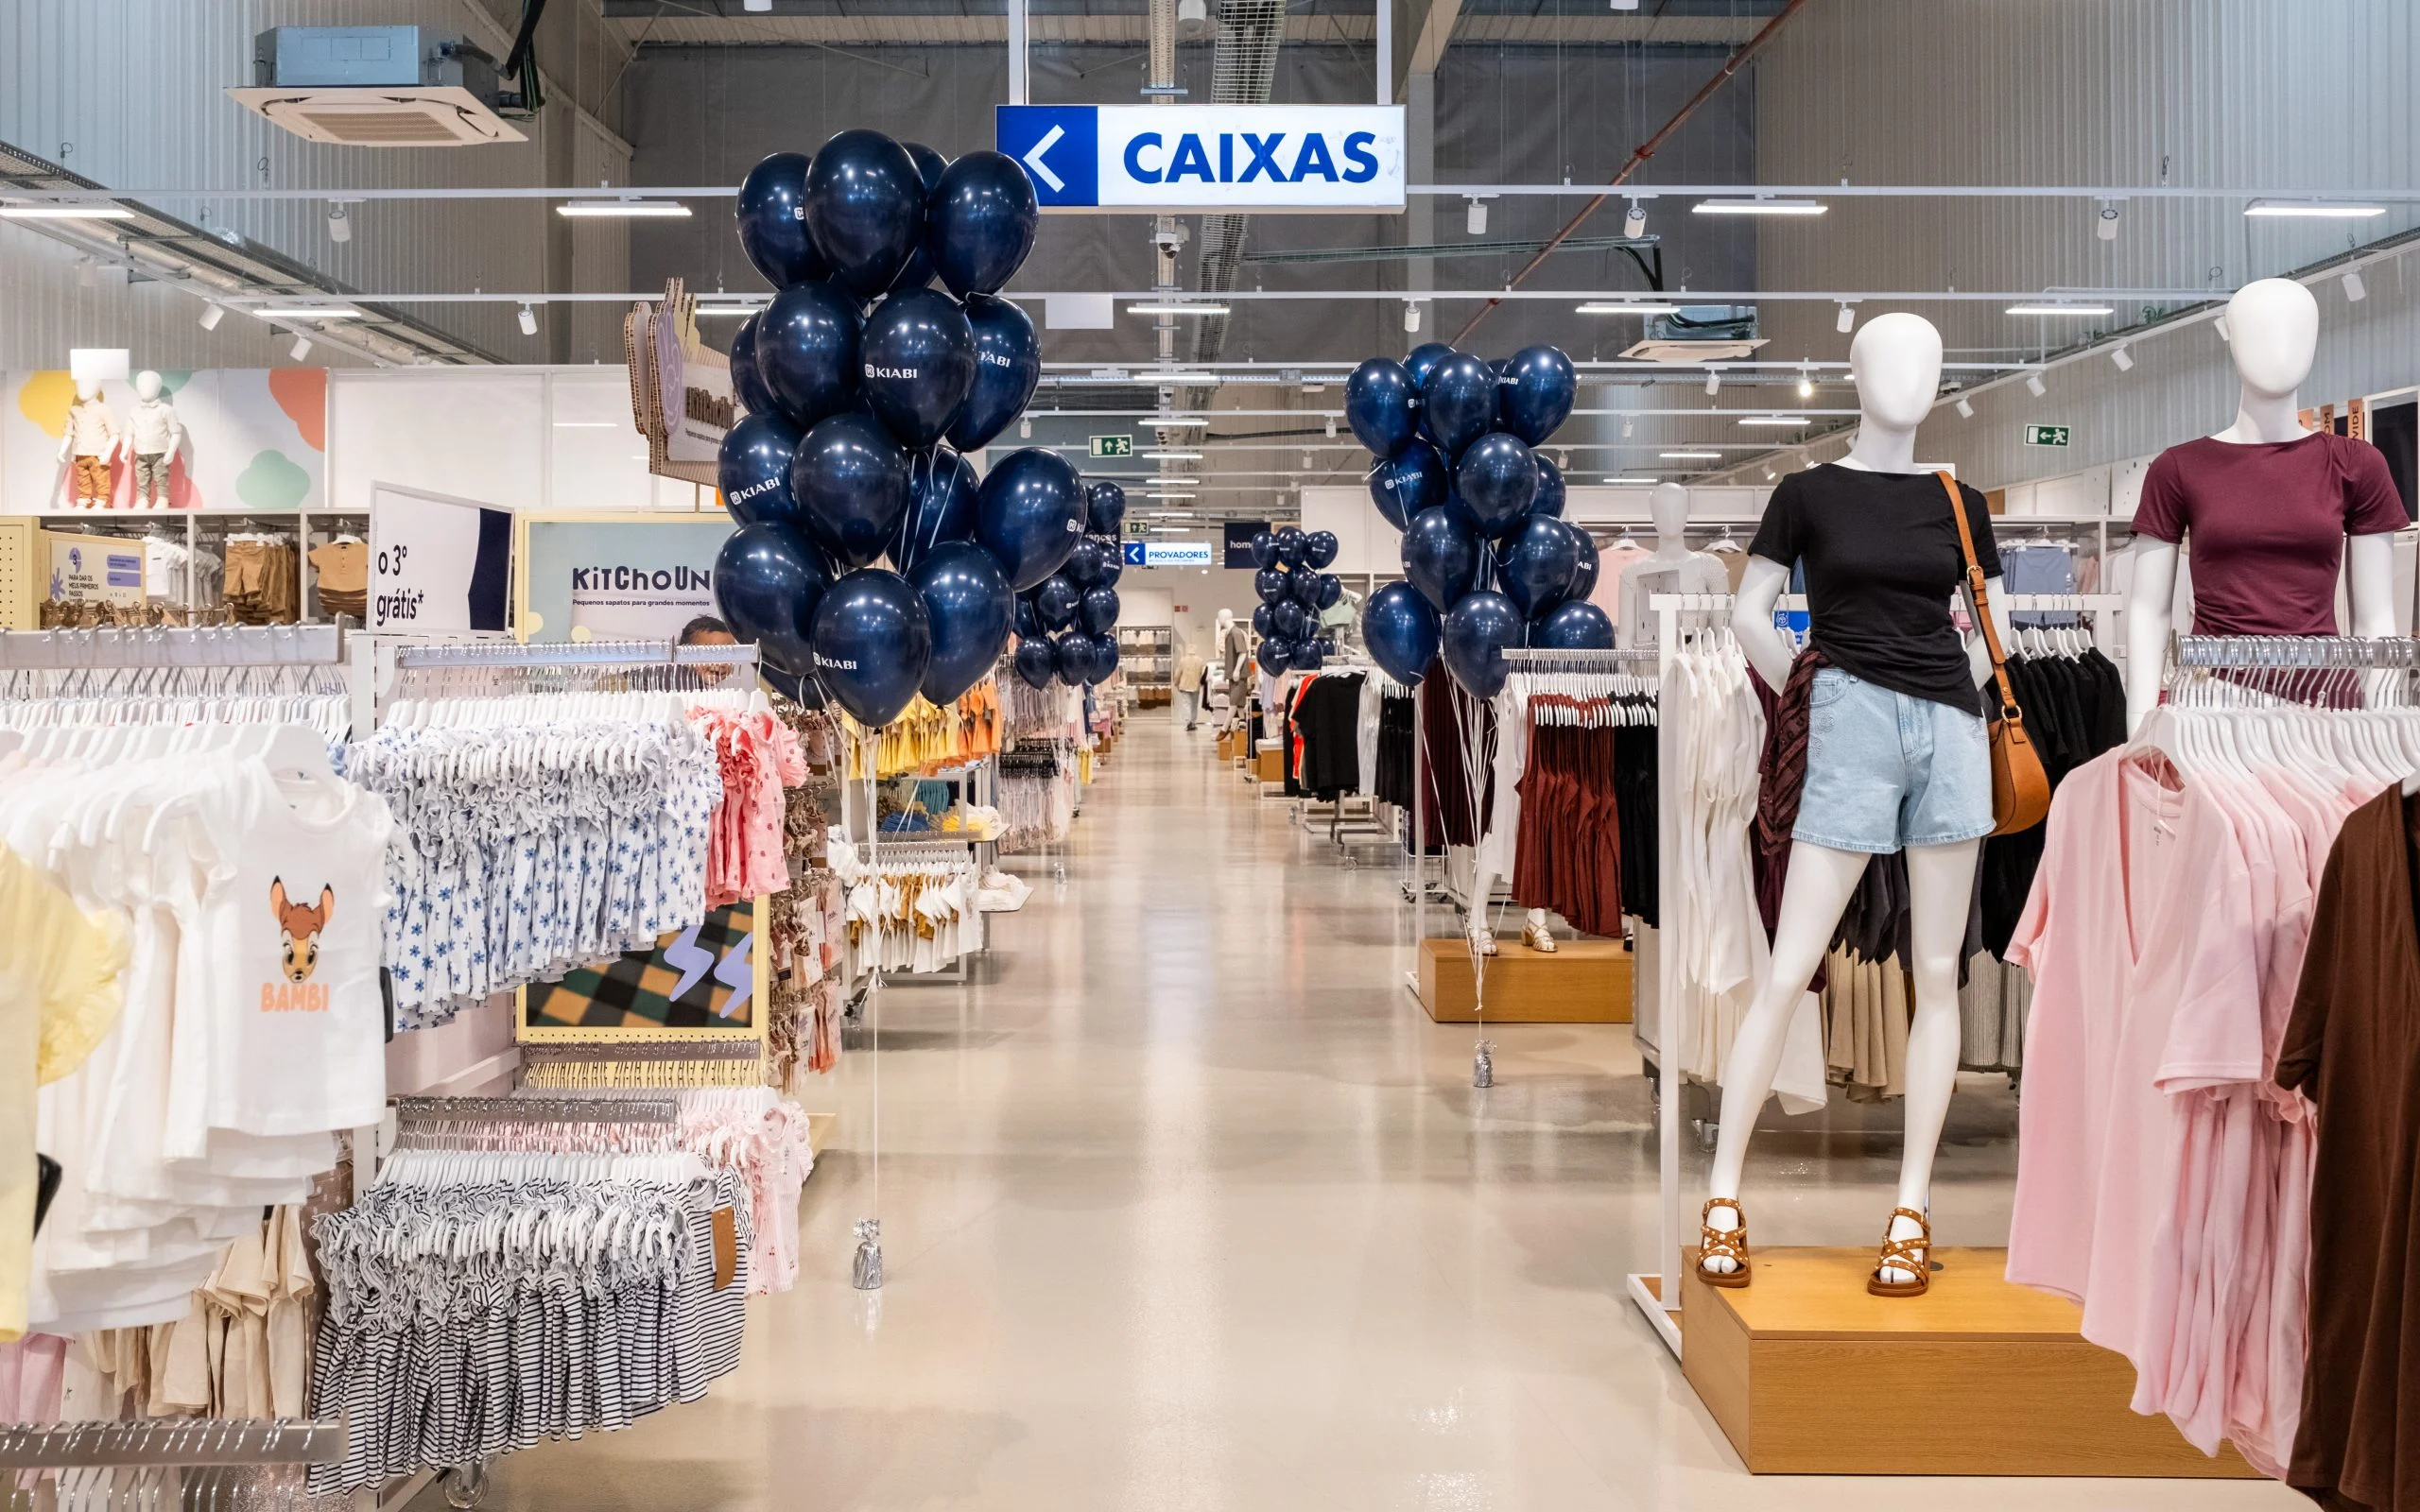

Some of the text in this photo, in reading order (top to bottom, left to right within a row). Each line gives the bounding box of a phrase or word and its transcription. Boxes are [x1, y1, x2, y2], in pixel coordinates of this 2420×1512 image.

[1124, 130, 1379, 184] CAIXAS
[876, 367, 918, 379] KIABI
[740, 476, 781, 500] KIABI
[378, 551, 389, 576] o
[572, 598, 604, 607] Pequenos
[648, 599, 674, 608] grandes
[821, 656, 857, 670] KIABI
[260, 982, 329, 1012] BAMBI
